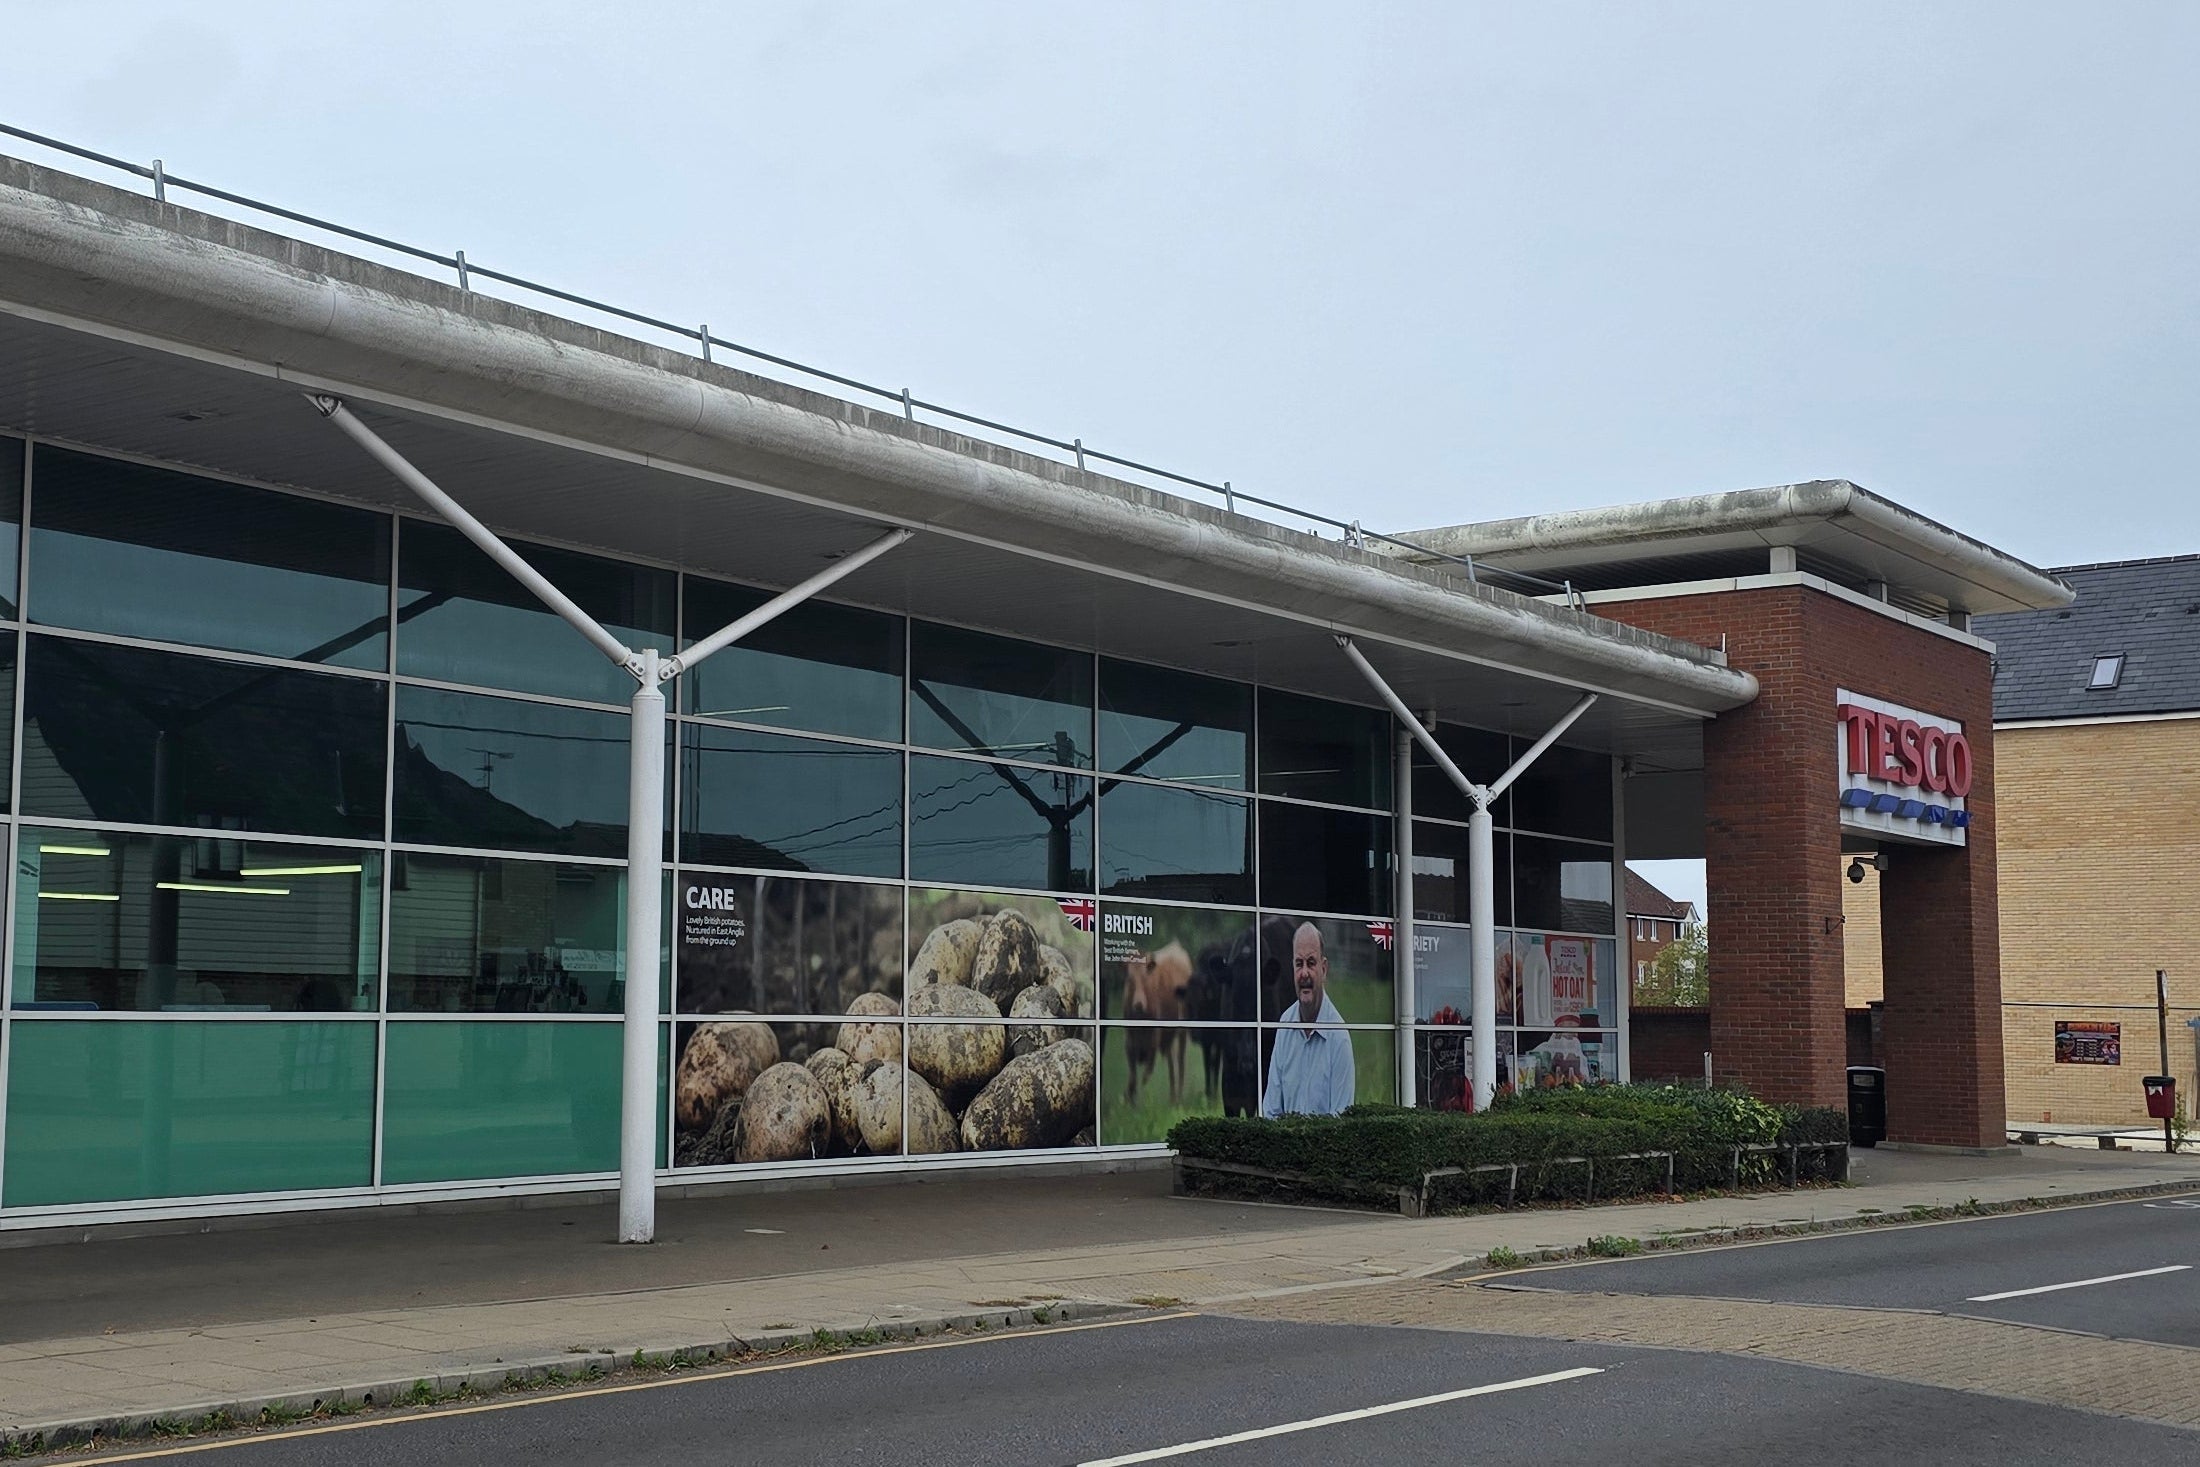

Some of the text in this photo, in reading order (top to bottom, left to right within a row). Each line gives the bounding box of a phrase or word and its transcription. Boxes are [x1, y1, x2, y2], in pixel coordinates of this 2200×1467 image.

[1838, 704, 1972, 797] TESCO
[686, 886, 734, 910] CARE
[686, 915, 703, 926] Lovely
[704, 916, 720, 925] British
[1104, 914, 1153, 935] BRITISH
[686, 925, 710, 935] Nurtured
[717, 927, 728, 935] East
[729, 927, 745, 937] Anglia
[686, 935, 737, 947] from the ground up
[1413, 935, 1440, 952] RIETY
[1553, 976, 1585, 999] HOT OAT
